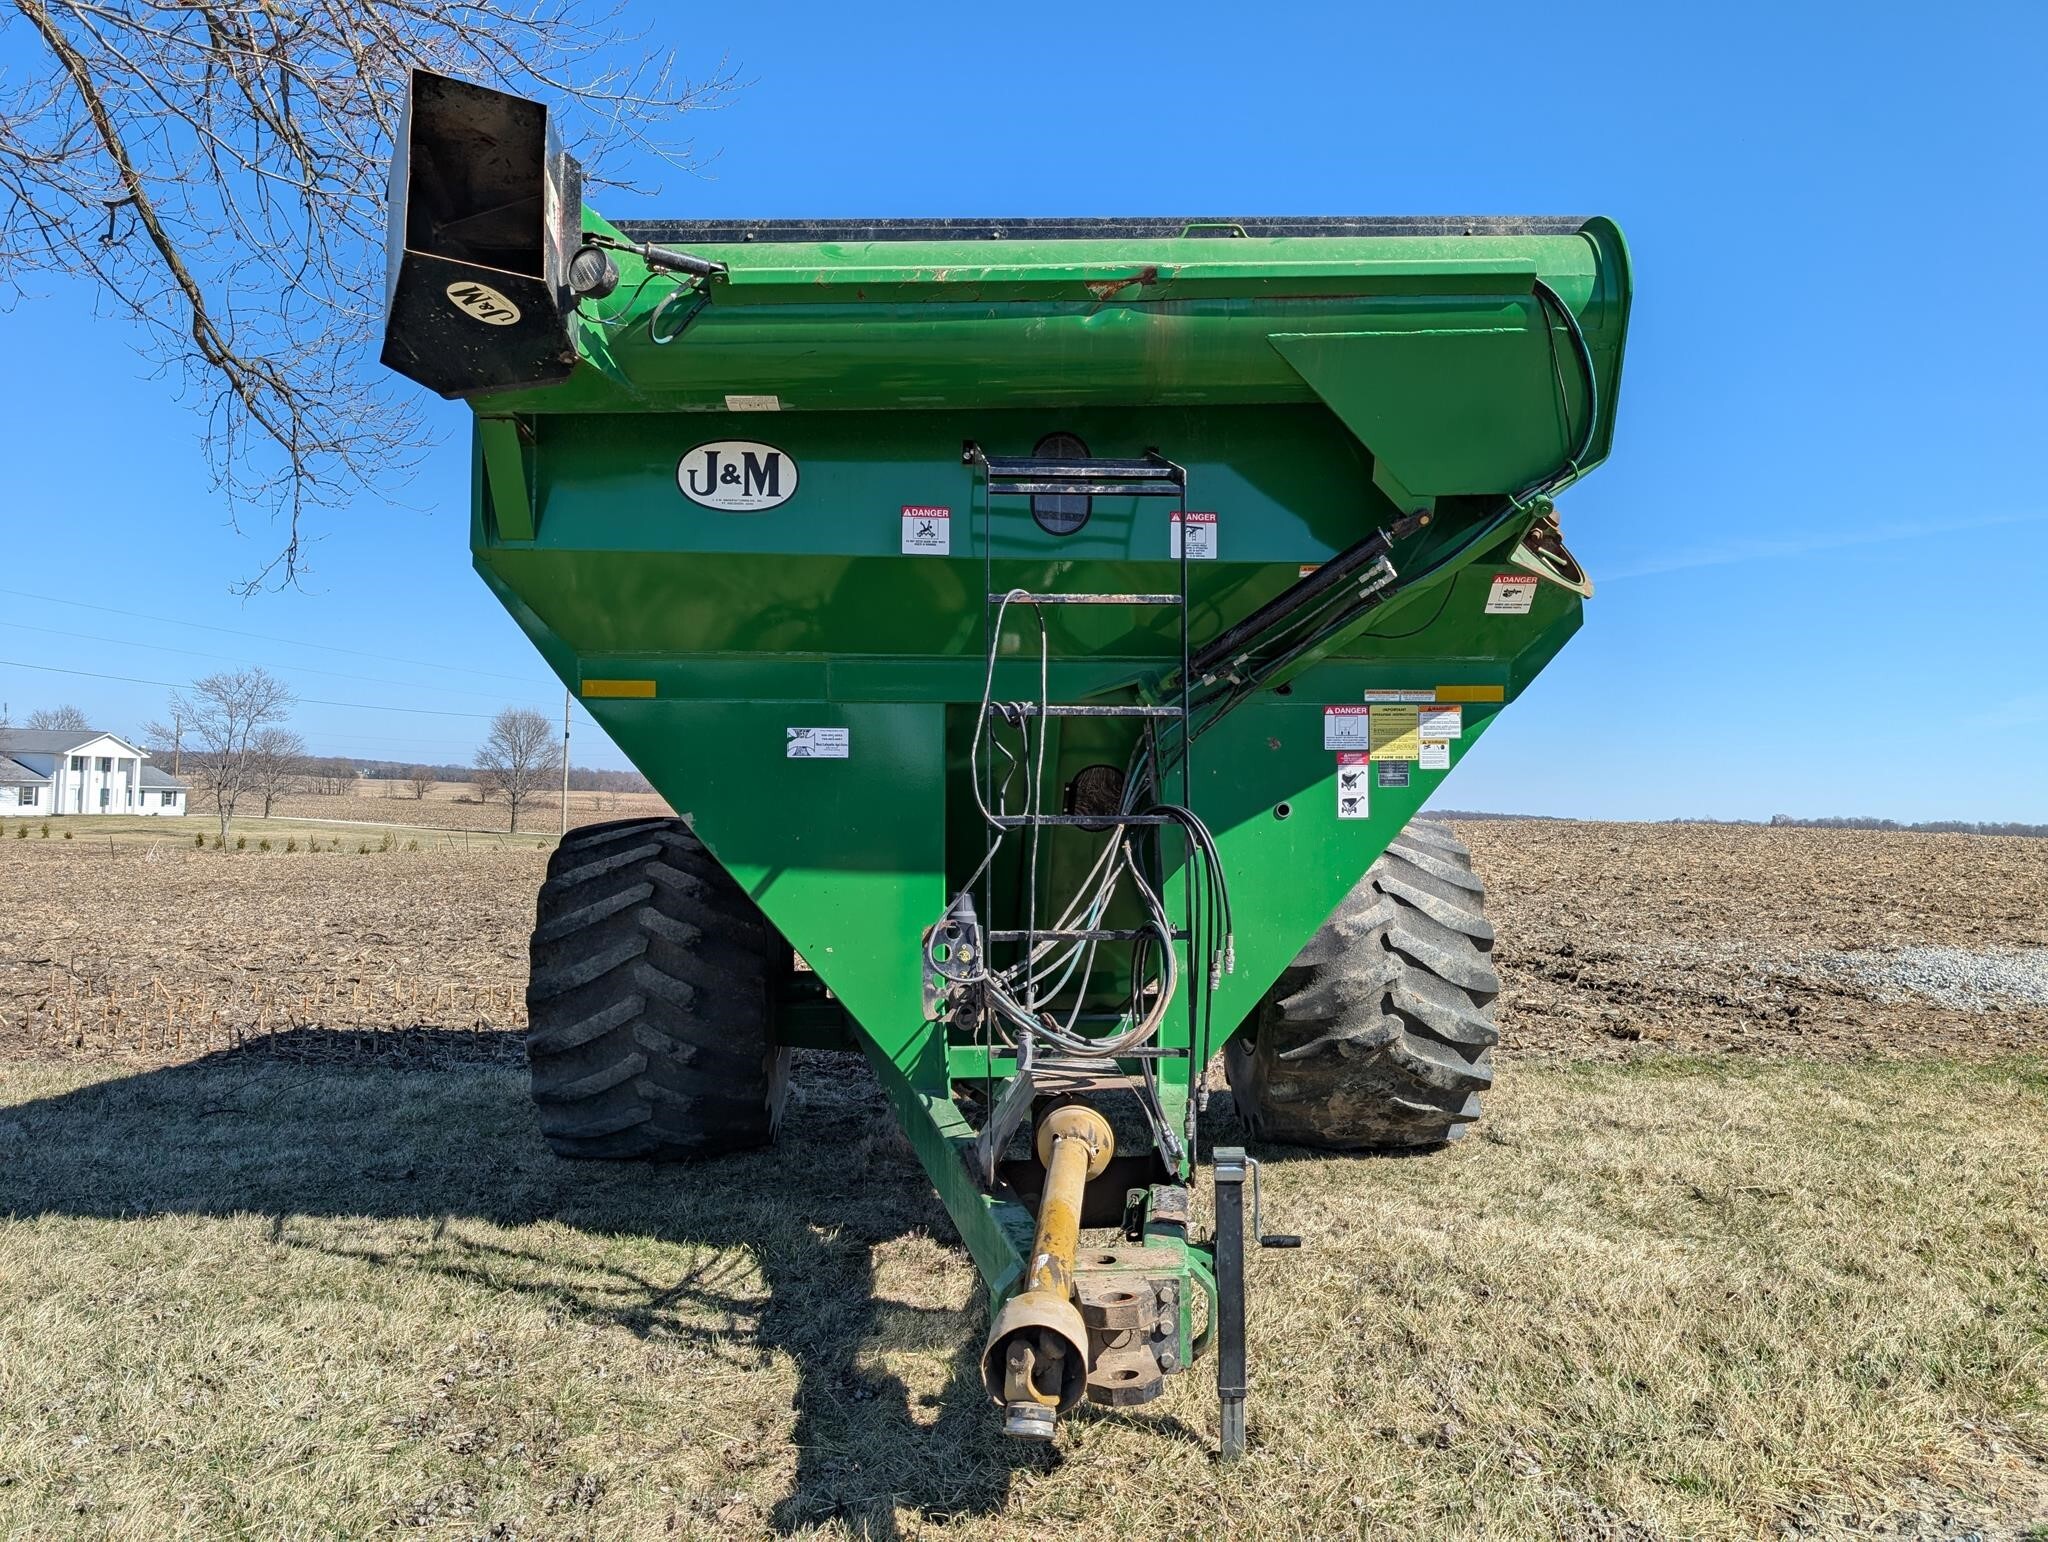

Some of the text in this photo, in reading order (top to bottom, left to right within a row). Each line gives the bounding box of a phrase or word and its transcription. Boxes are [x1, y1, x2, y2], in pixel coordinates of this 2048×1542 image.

[449, 285, 515, 322] J&M
[687, 451, 782, 497] J&M
[911, 508, 949, 517] DANGER
[1181, 513, 1216, 521] ANGER
